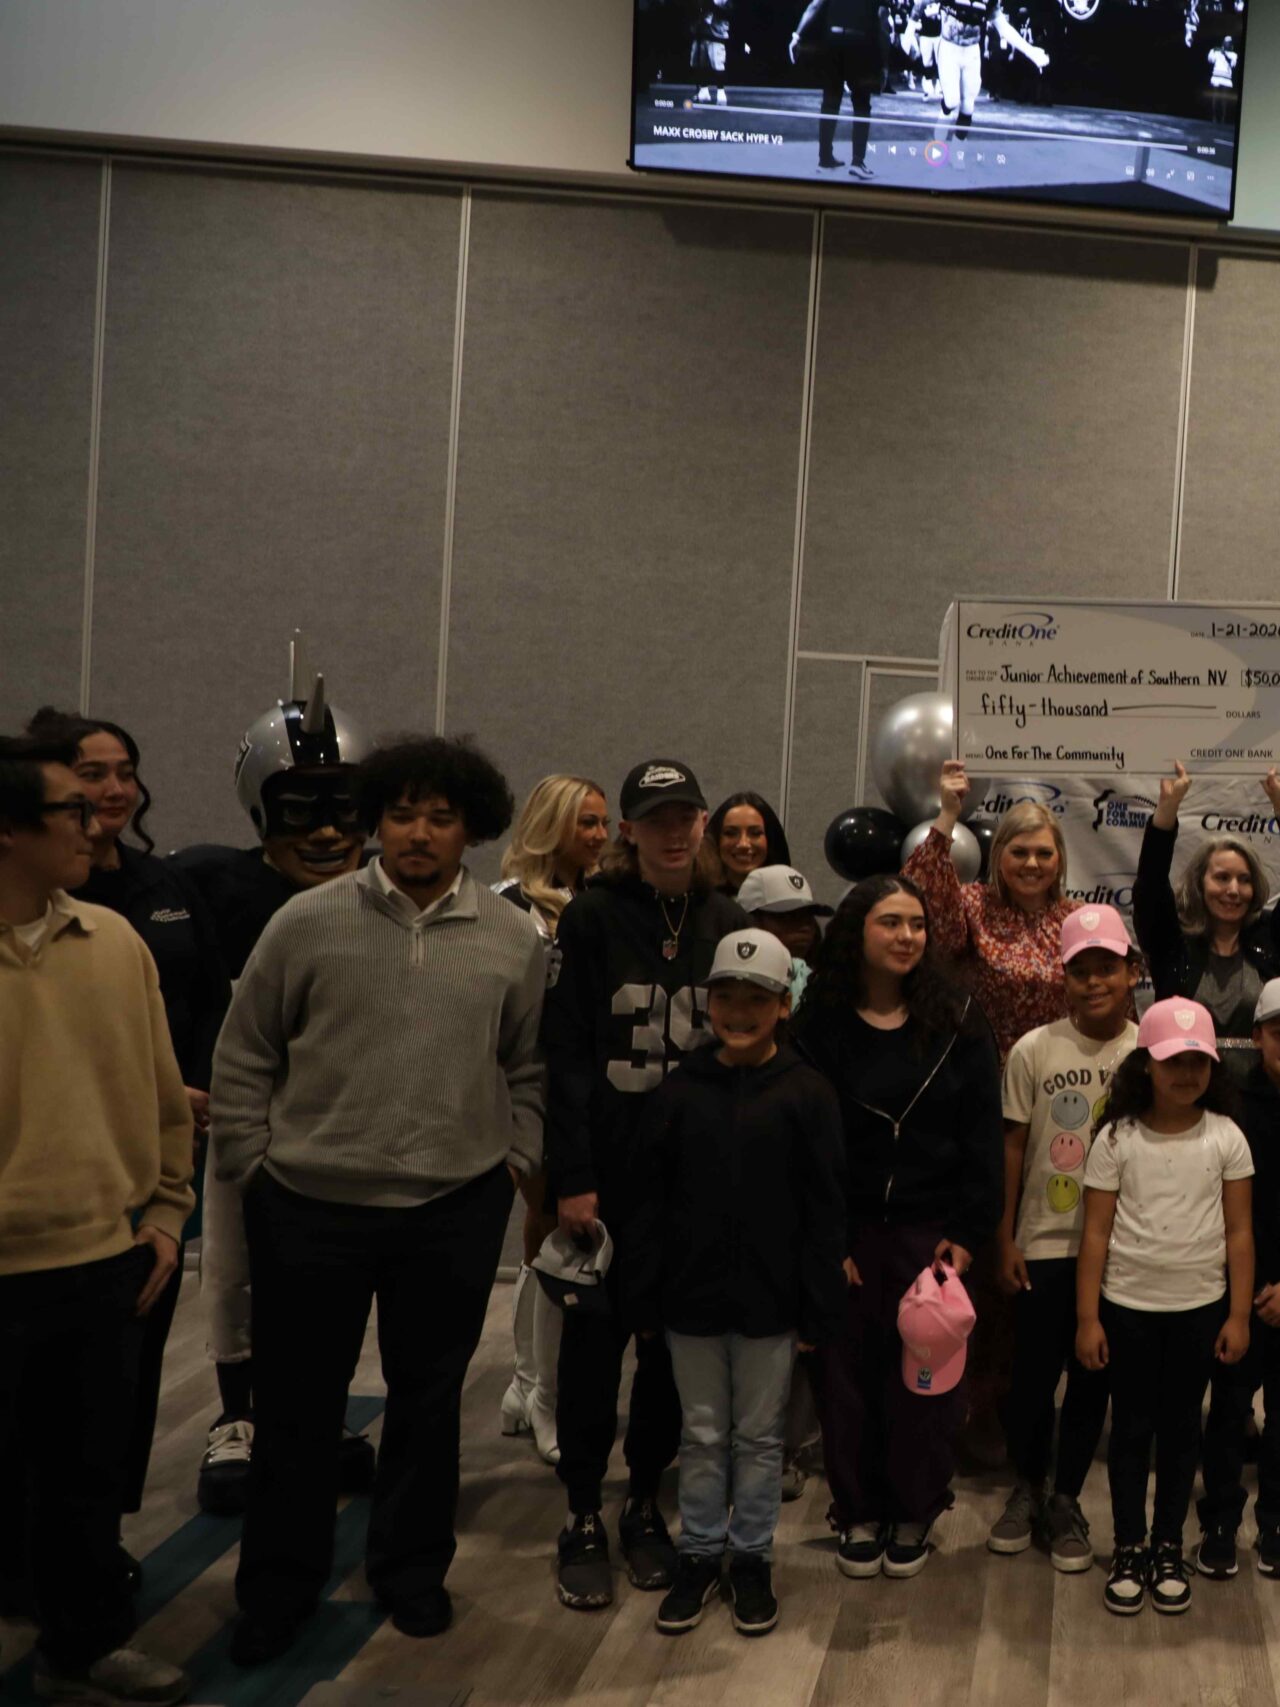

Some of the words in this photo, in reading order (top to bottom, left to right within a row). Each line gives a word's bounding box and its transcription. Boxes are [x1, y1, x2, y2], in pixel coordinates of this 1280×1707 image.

[653, 125, 680, 138] MAXX
[683, 128, 718, 140] CROSBY
[721, 131, 744, 142] SACK
[746, 133, 769, 144] HYPE
[967, 623, 1057, 640] CreditOne
[1000, 665, 1043, 683] Junior
[1047, 664, 1128, 684] Achievement
[1131, 671, 1144, 684] of
[1148, 670, 1200, 685] Southern
[1208, 669, 1227, 685] NV
[1226, 711, 1261, 719] DOLLARS
[985, 745, 1008, 760] One
[1011, 746, 1029, 760] For
[1031, 746, 1052, 760] The
[1056, 746, 1125, 769] Community
[1190, 749, 1222, 758] CREDIT
[1225, 749, 1245, 758] ONE
[1248, 749, 1273, 759] BANK
[1107, 810, 1126, 818] FOR
[1108, 802, 1127, 810] ONE
[1043, 1069, 1092, 1095] GOOD
